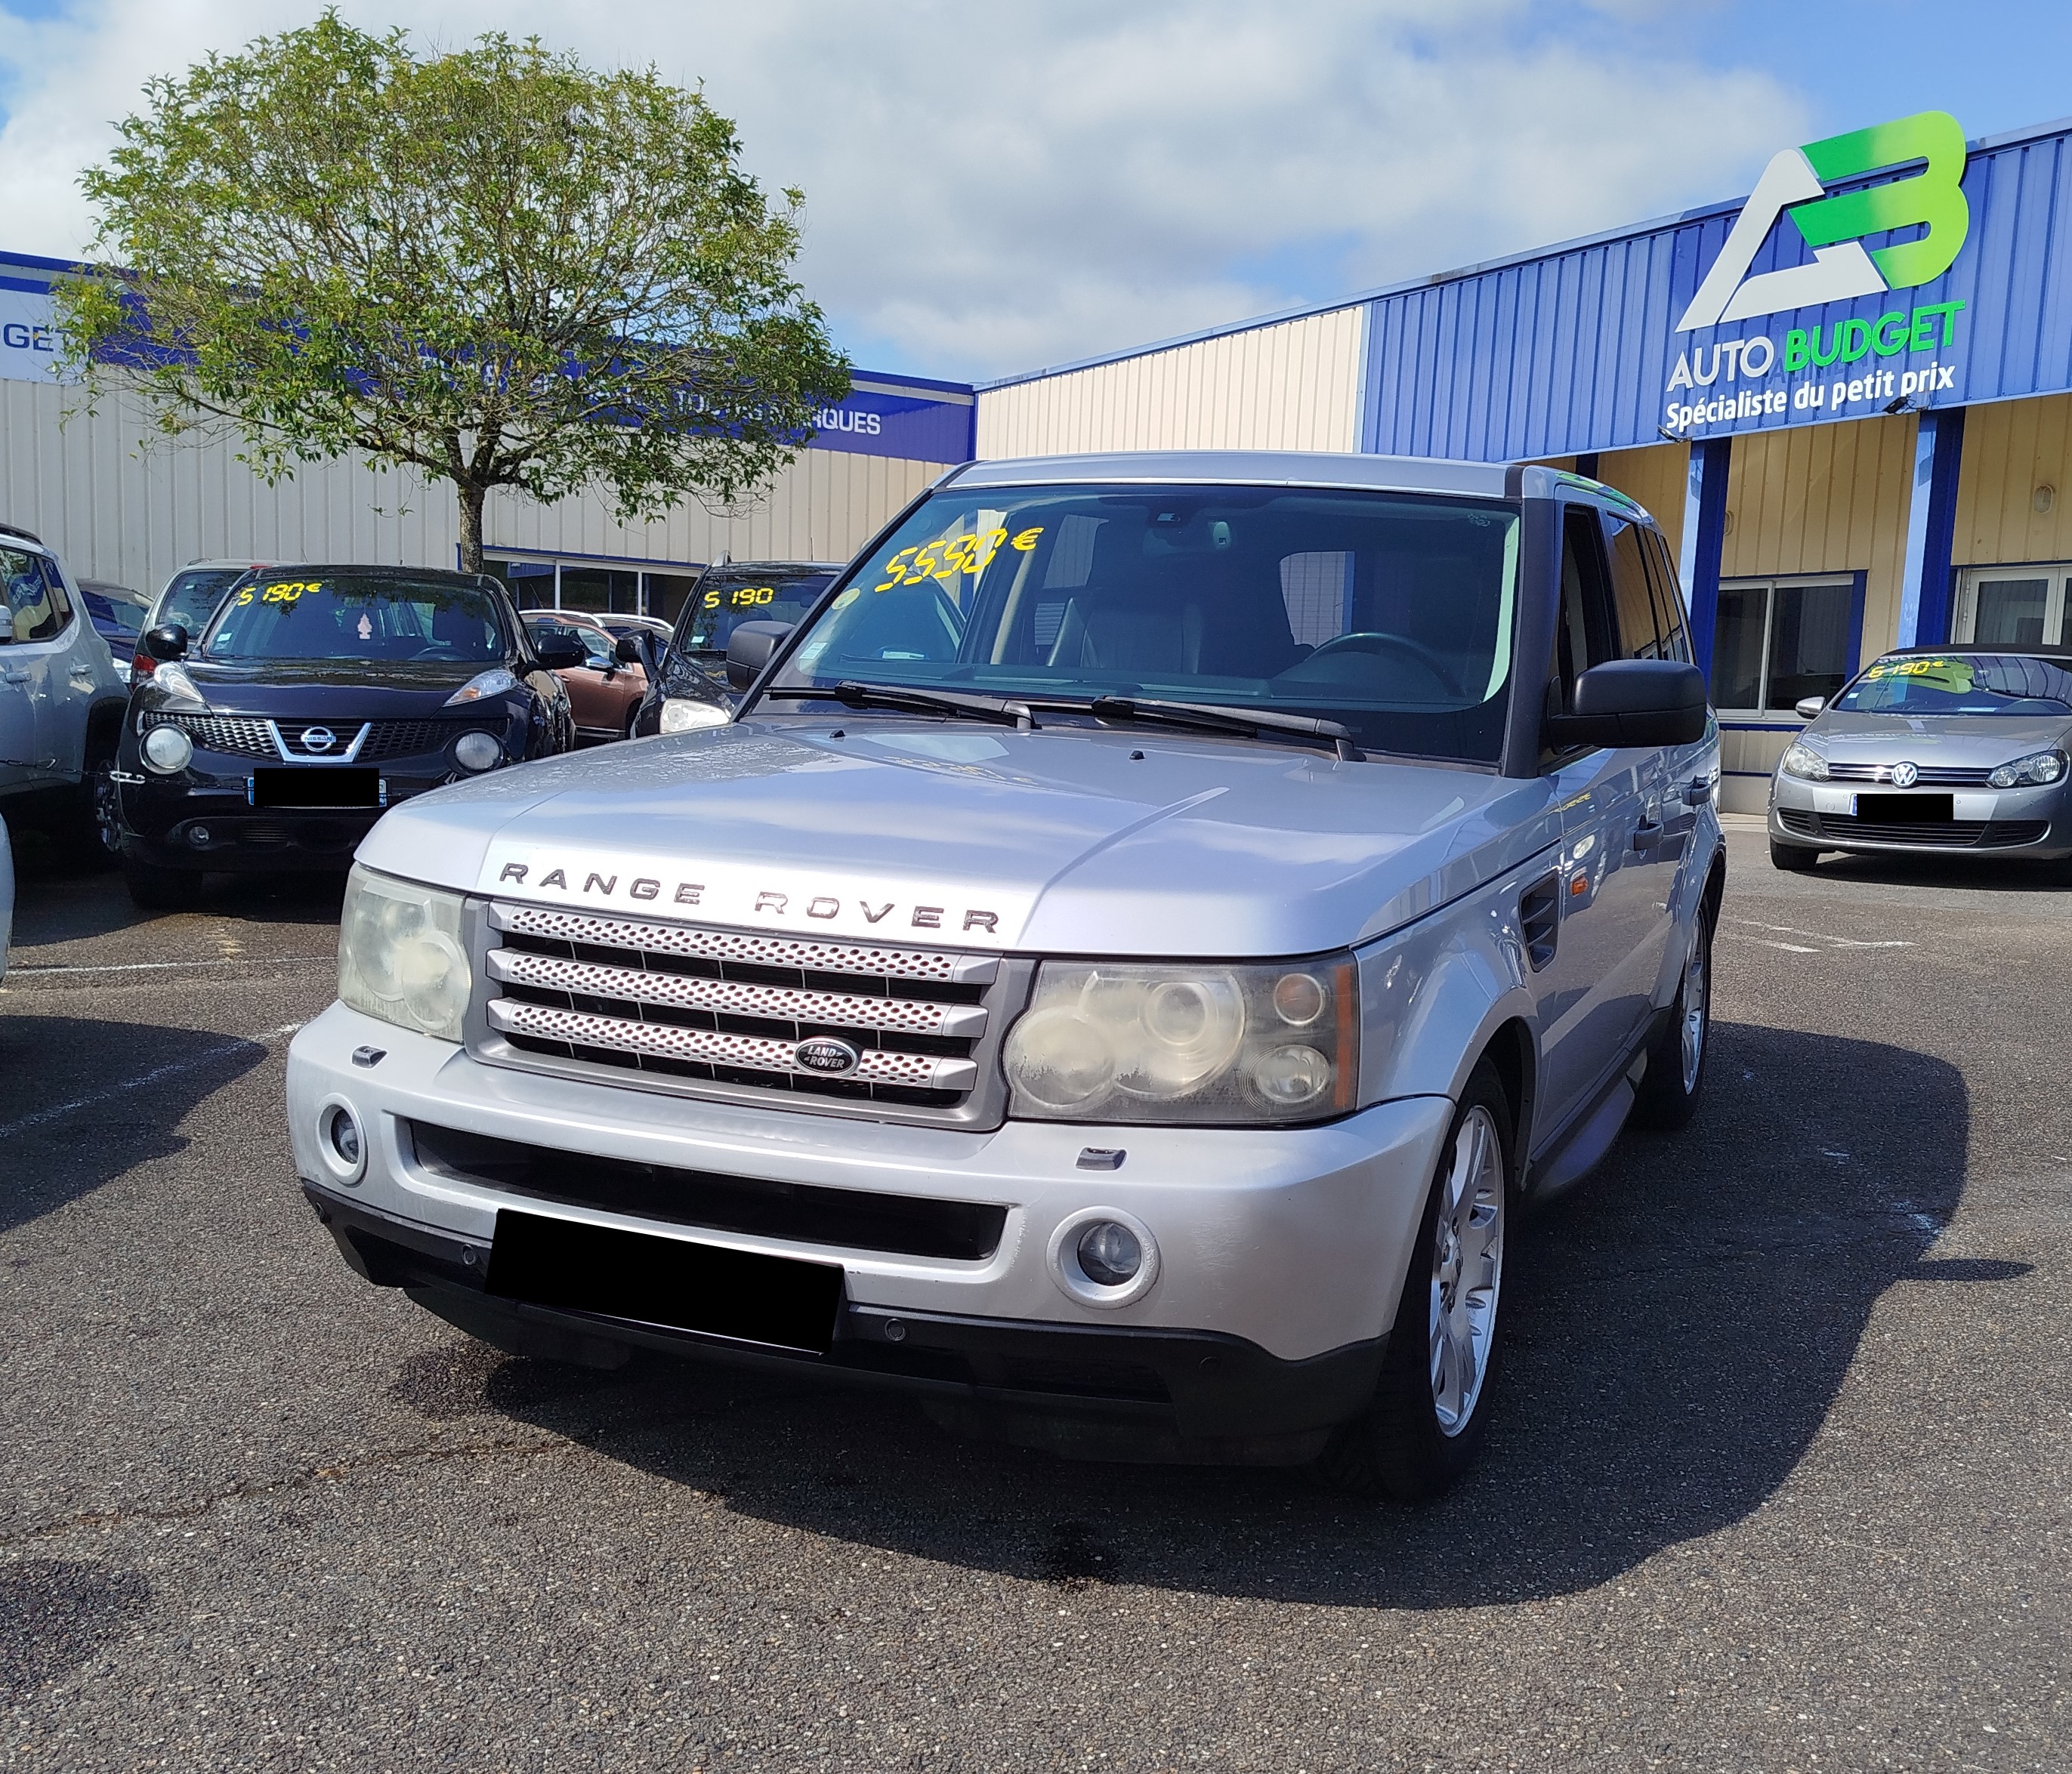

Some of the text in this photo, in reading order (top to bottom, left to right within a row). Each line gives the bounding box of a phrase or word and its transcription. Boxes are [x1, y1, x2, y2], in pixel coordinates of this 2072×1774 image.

[1666, 336, 1774, 393] AUTO
[1784, 299, 1966, 372] BUDGET
[1666, 388, 1788, 433] Spécialiste
[1793, 381, 1825, 409] du
[1831, 370, 1895, 411] petit
[1901, 361, 1956, 397] prix
[499, 862, 999, 934] RANGE ROVER
[807, 1045, 837, 1057] LAND
[809, 1055, 845, 1069] ROVER
